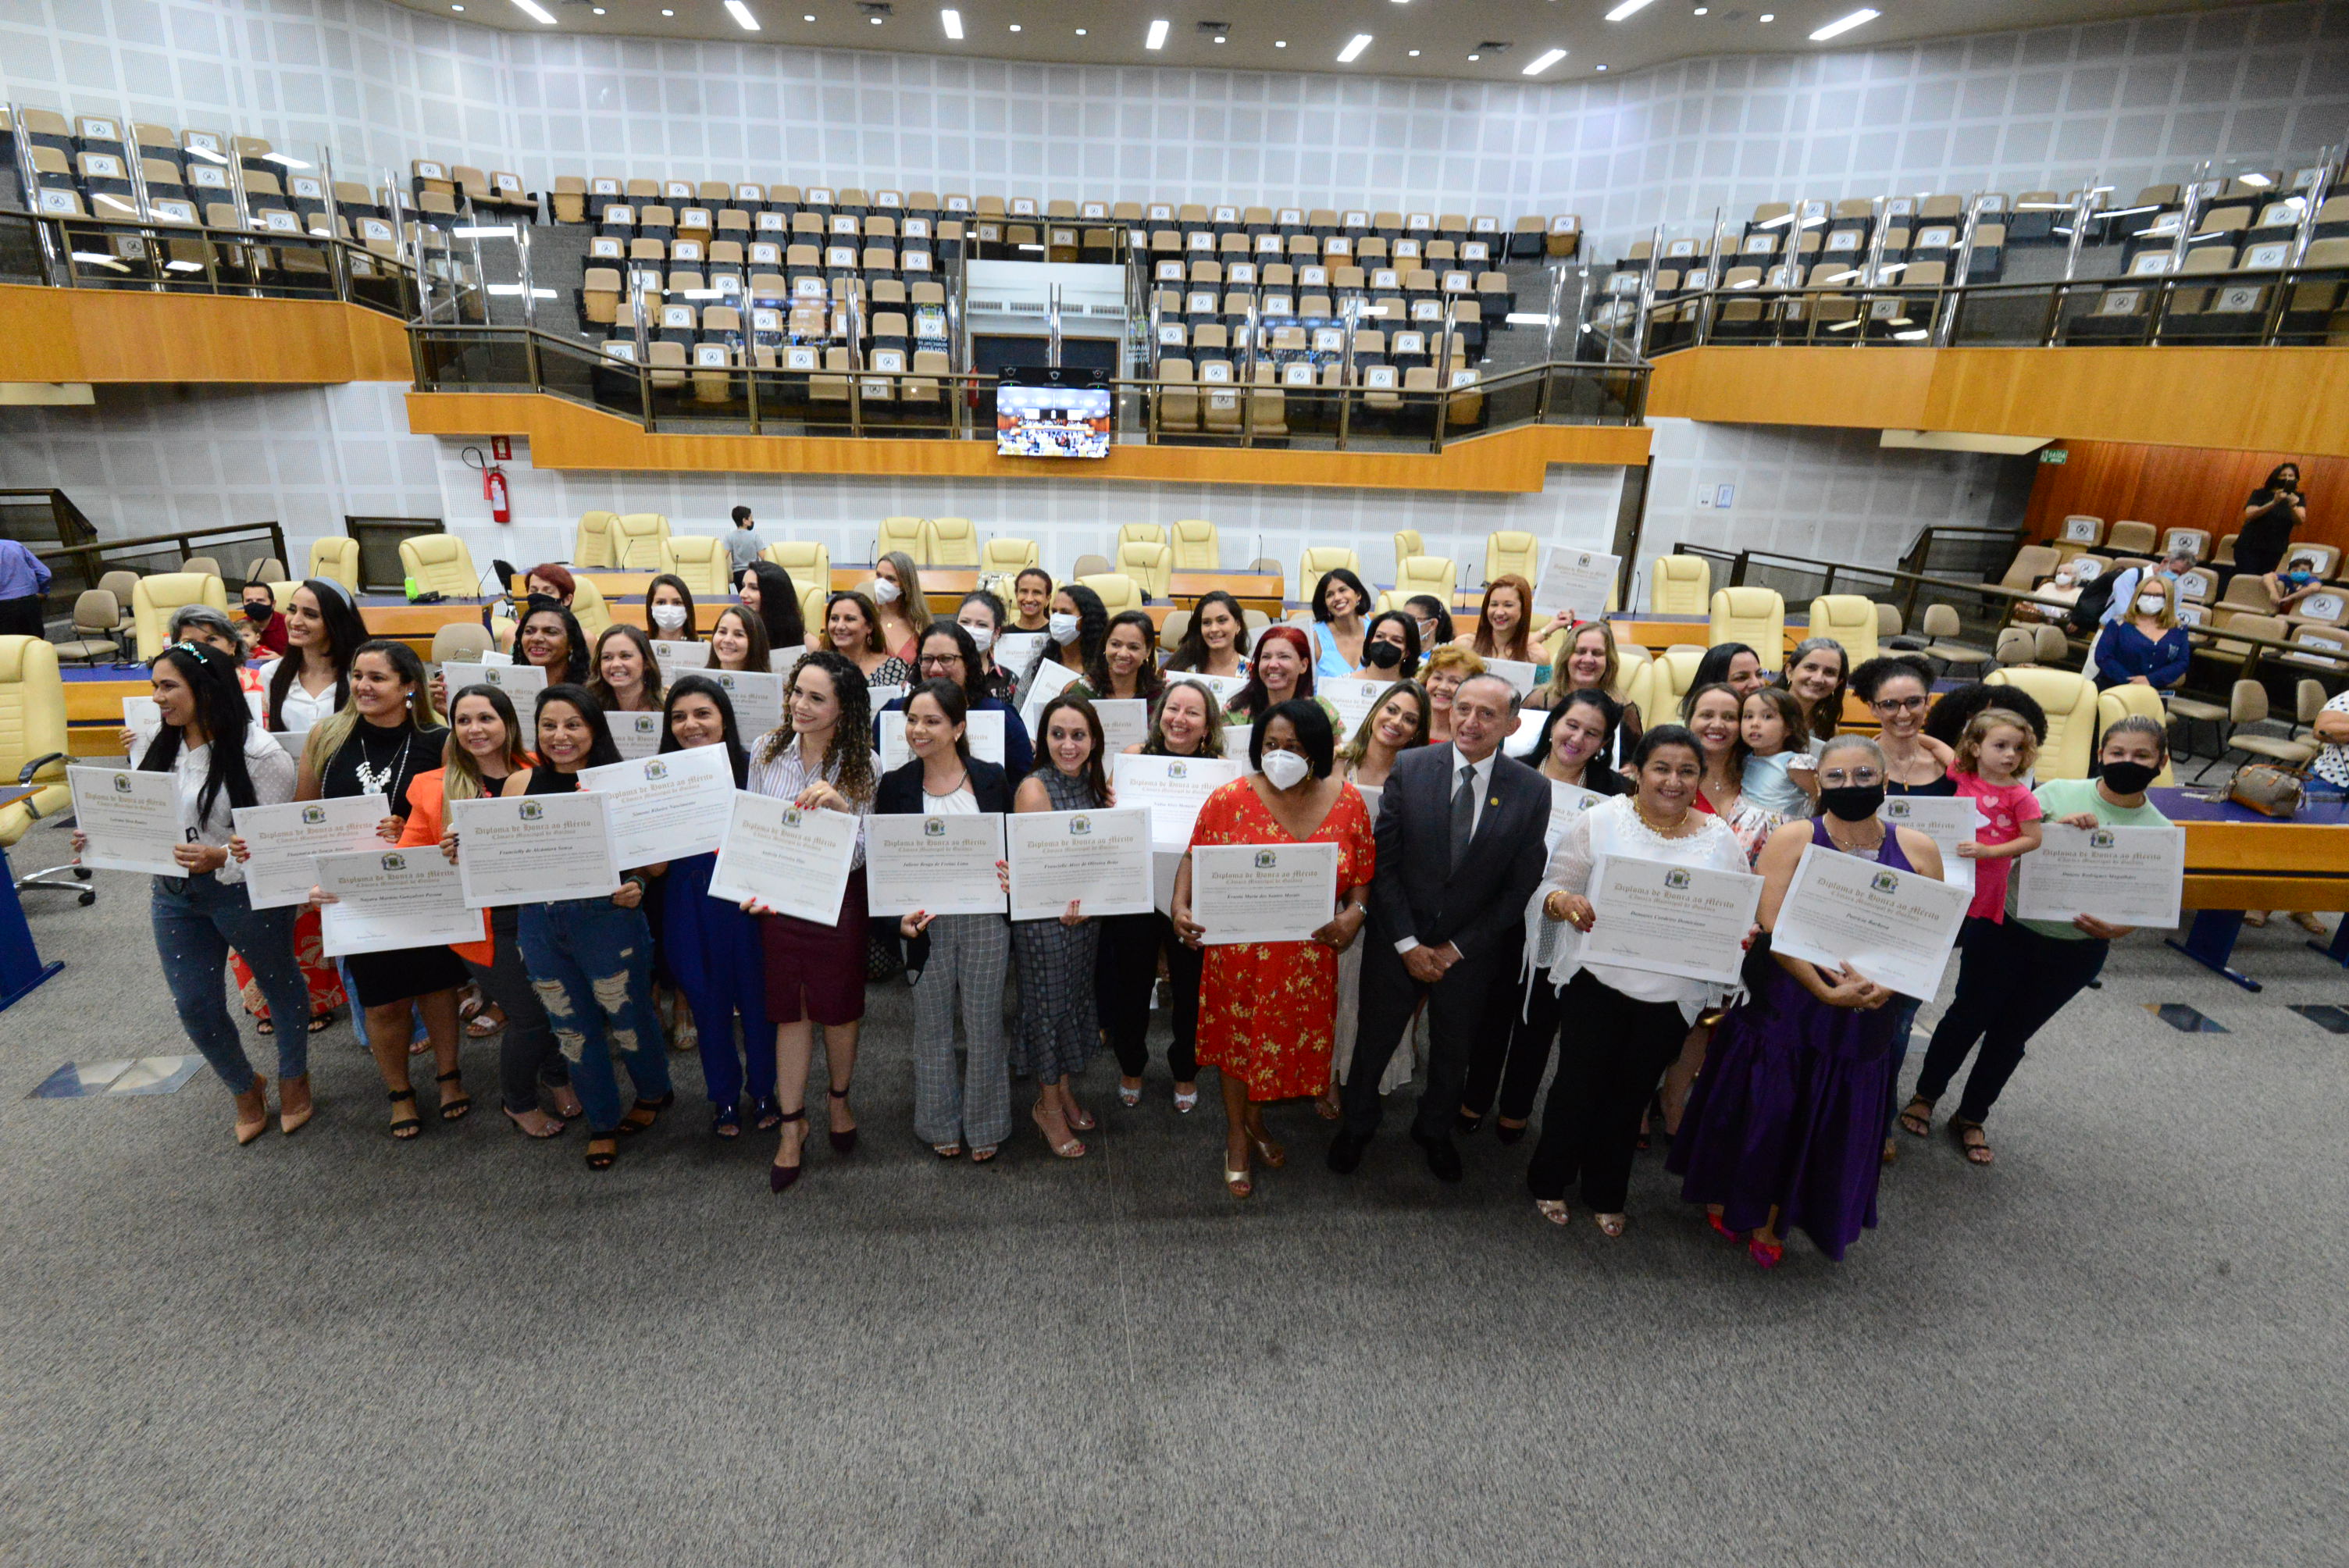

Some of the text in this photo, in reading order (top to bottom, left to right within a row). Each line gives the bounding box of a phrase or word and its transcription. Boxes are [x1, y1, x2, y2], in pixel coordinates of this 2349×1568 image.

[650, 780, 674, 791] Honra
[686, 772, 713, 783] Mérito
[474, 825, 509, 835] Diploma
[523, 822, 549, 831] Honra
[562, 819, 591, 828] Mérito
[1027, 840, 1058, 849] Diploma
[1108, 835, 1133, 843] Mérito
[337, 874, 373, 884] Diploma
[387, 872, 412, 880] Honra
[427, 868, 454, 877] Mérito
[1613, 883, 1650, 895] Diploma
[1663, 890, 1690, 901] Honra
[1705, 896, 1735, 908] Mérito
[1816, 877, 1854, 894] Diploma
[1867, 893, 1895, 907] Honra
[1909, 905, 1941, 921] Mérito
